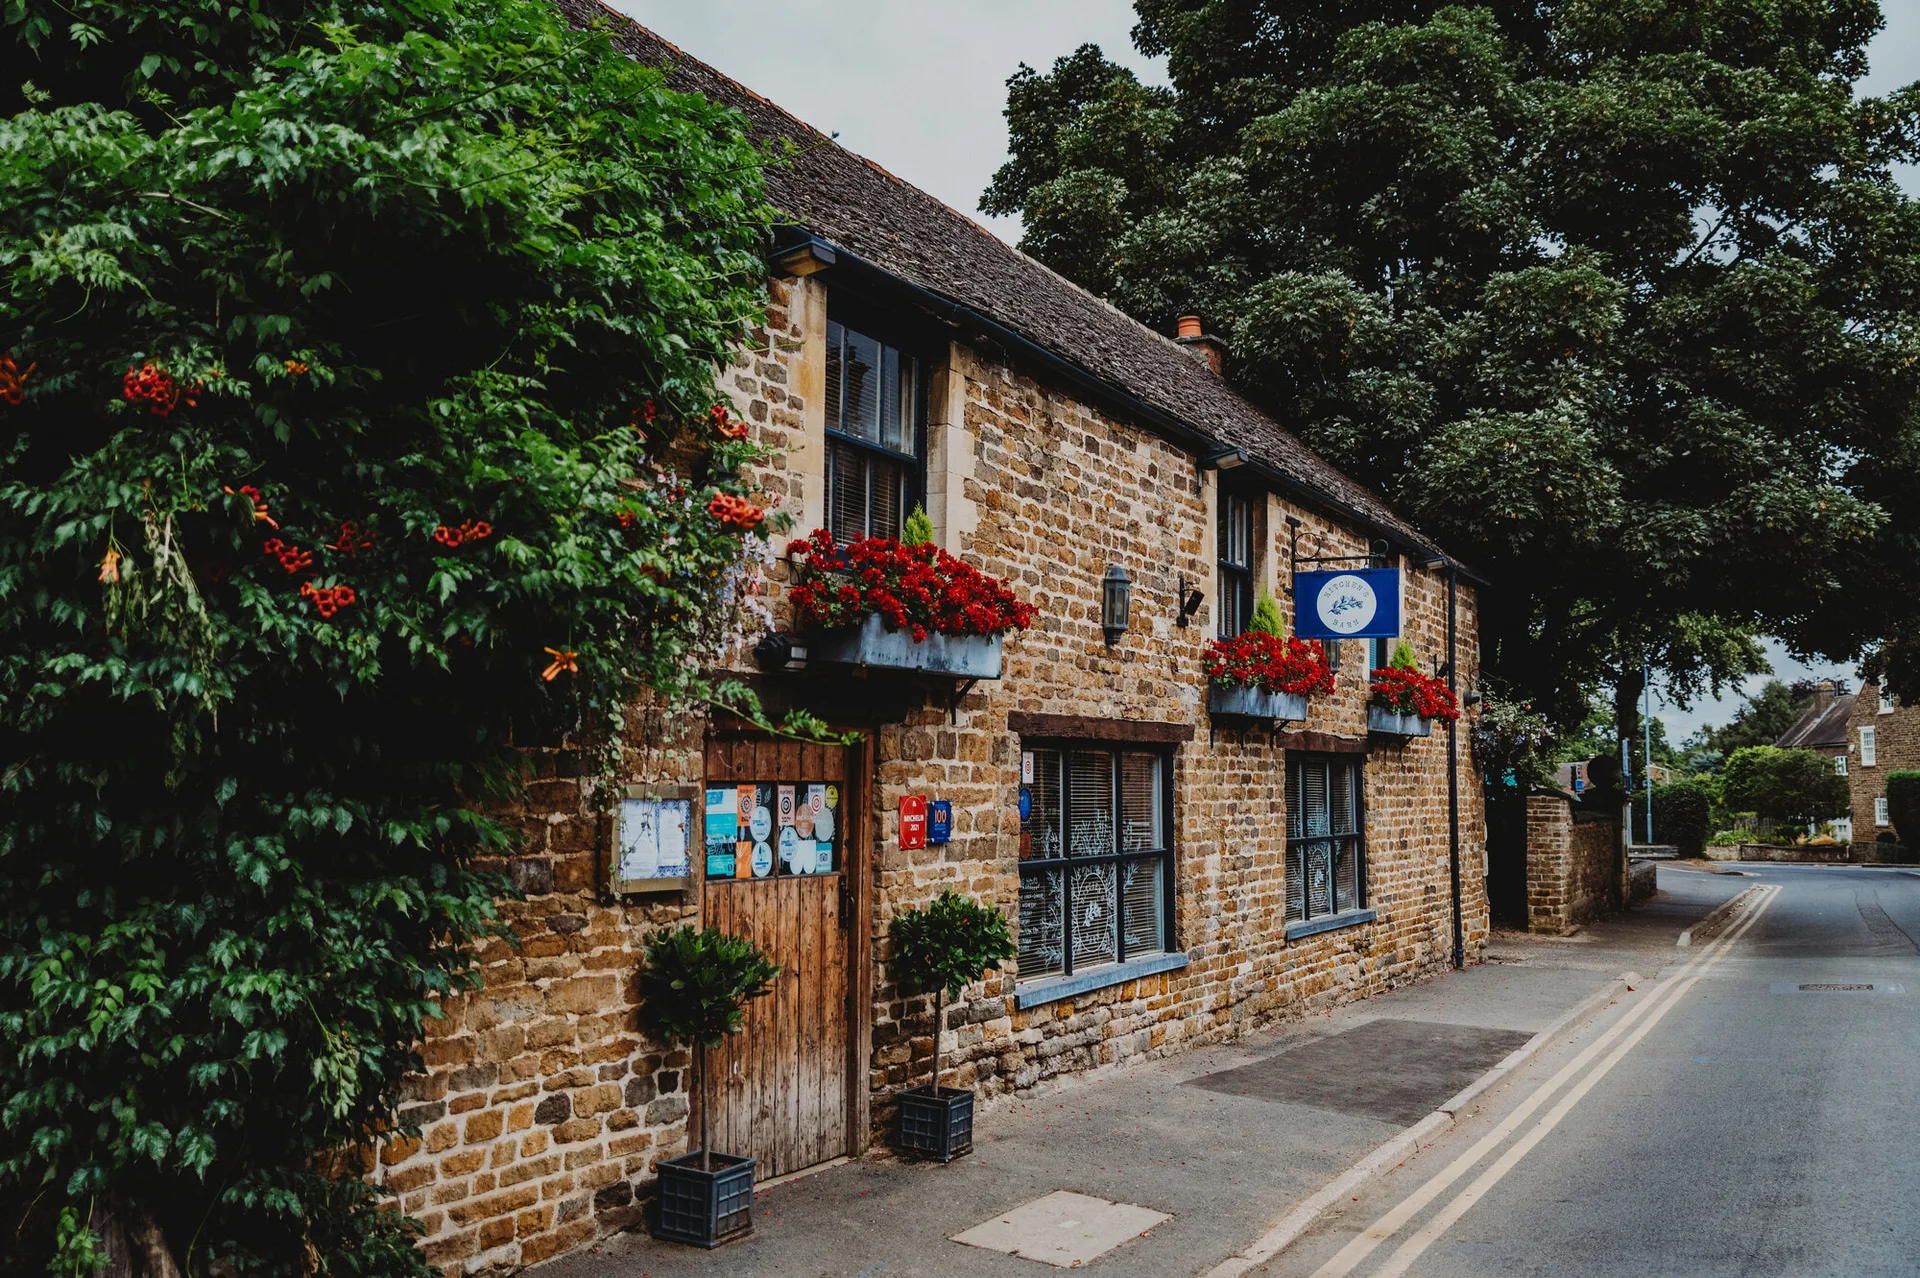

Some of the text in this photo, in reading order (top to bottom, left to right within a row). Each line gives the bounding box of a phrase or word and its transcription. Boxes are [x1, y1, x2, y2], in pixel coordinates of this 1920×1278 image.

[1323, 580, 1370, 598] HITCHEN'S
[1332, 618, 1360, 629] BARN
[903, 814, 925, 822] MICHELIN
[934, 809, 947, 823] 100
